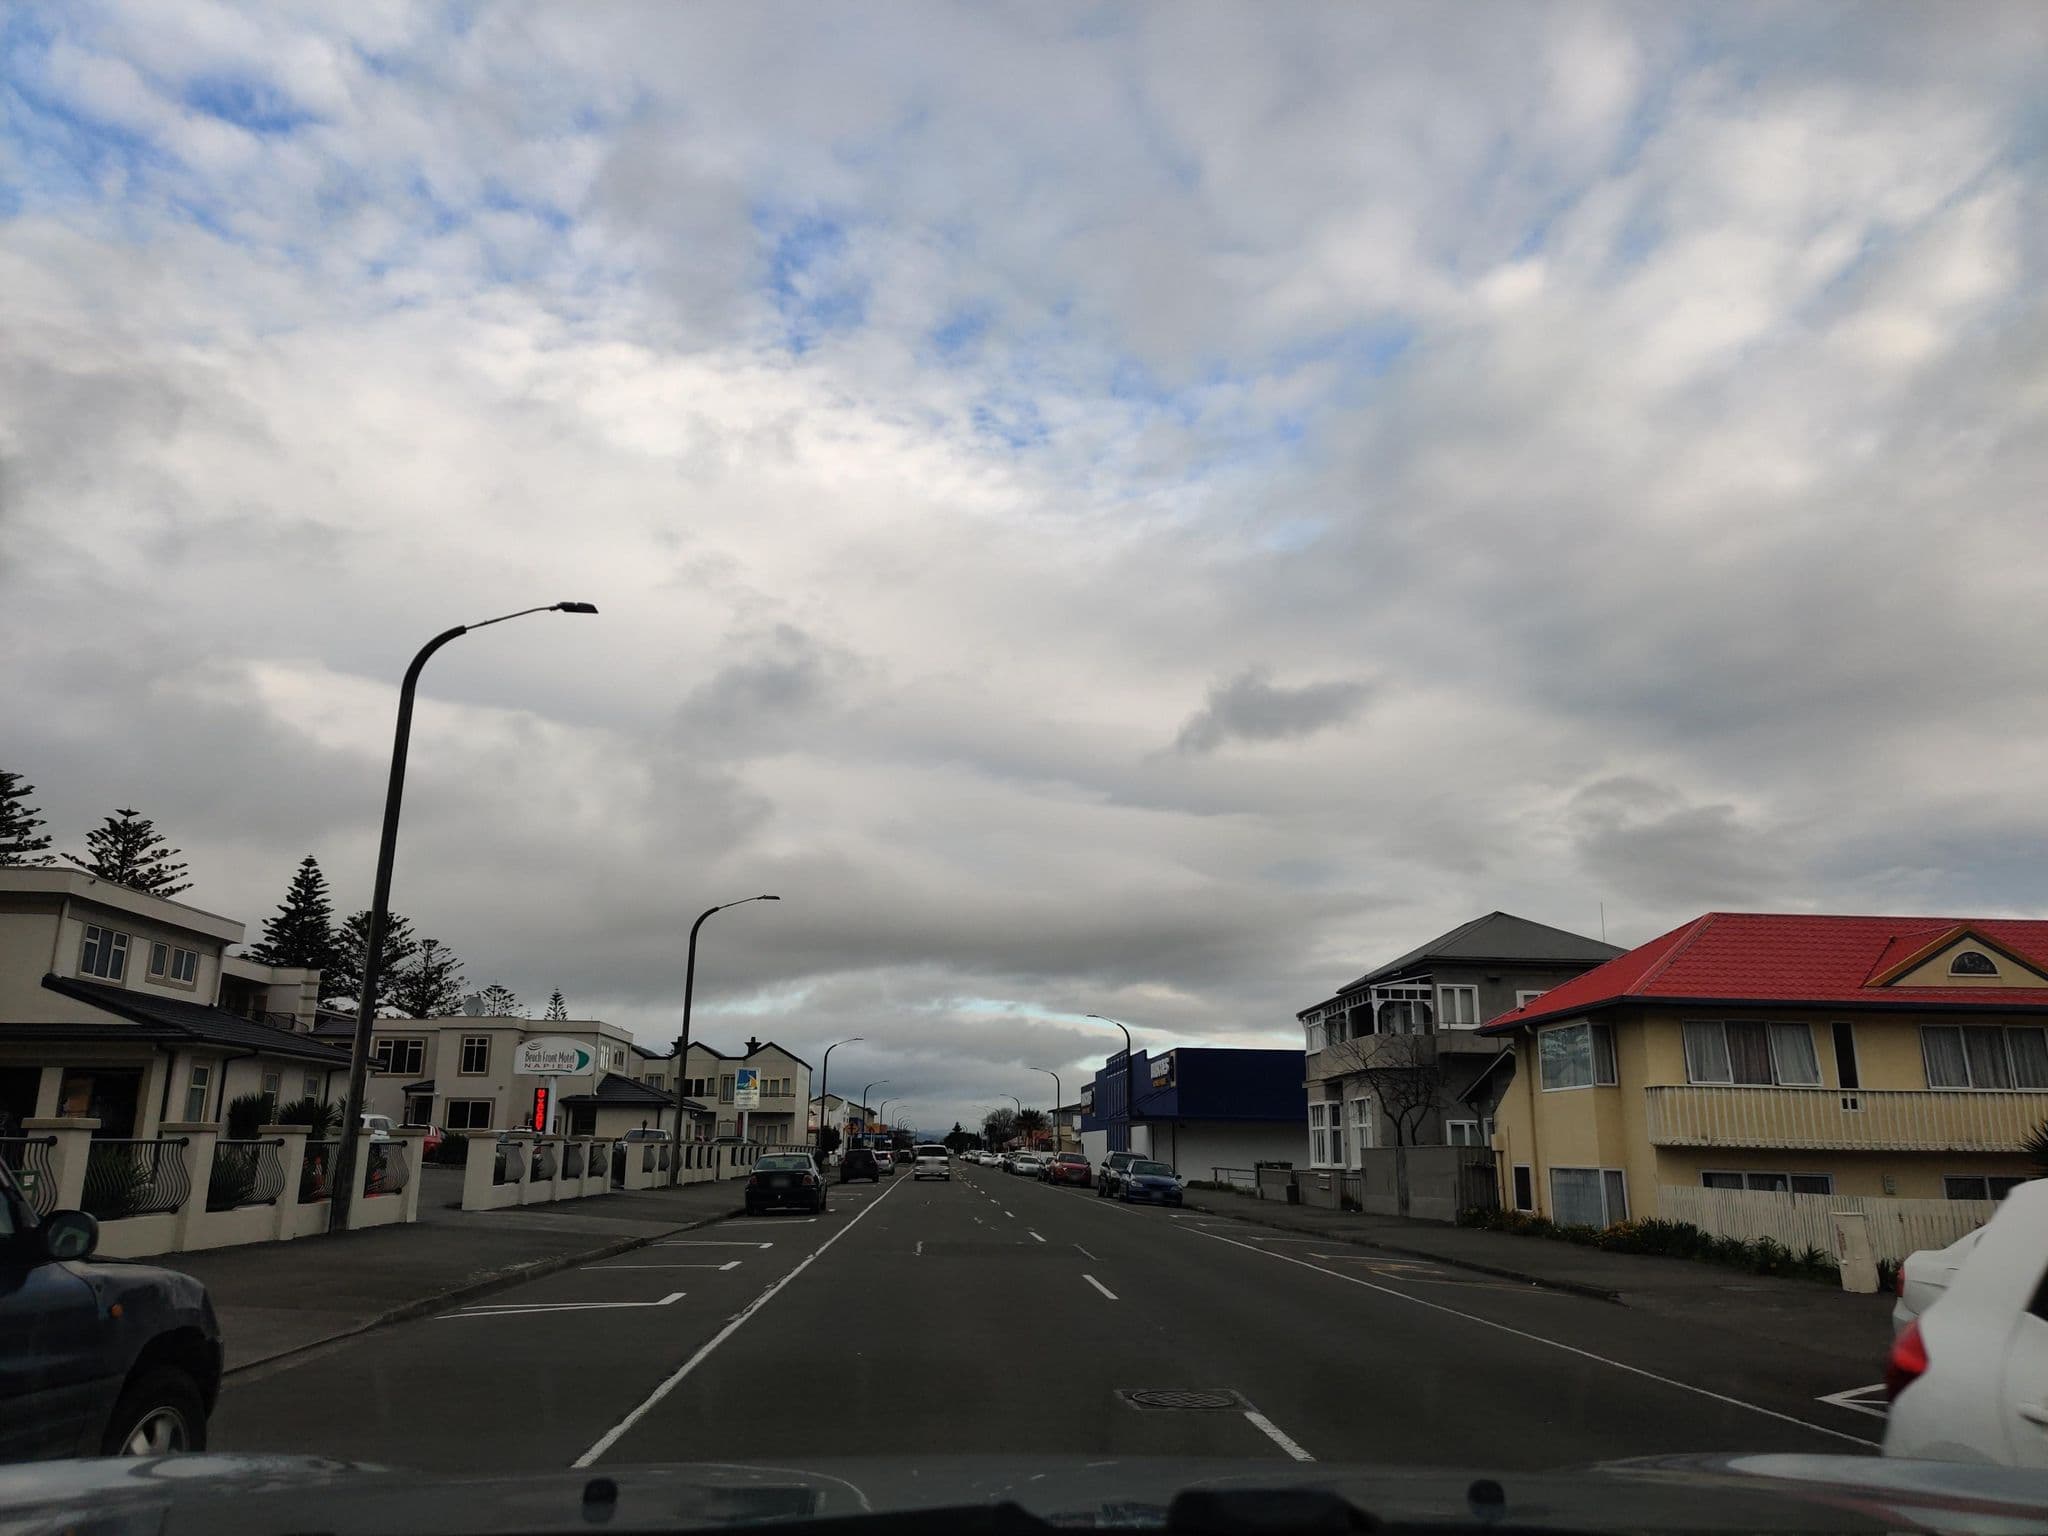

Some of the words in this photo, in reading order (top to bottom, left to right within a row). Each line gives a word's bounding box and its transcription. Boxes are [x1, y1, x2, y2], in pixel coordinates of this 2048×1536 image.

[525, 1051, 542, 1062] Beach
[543, 1051, 558, 1063] Front
[558, 1051, 575, 1063] Motel
